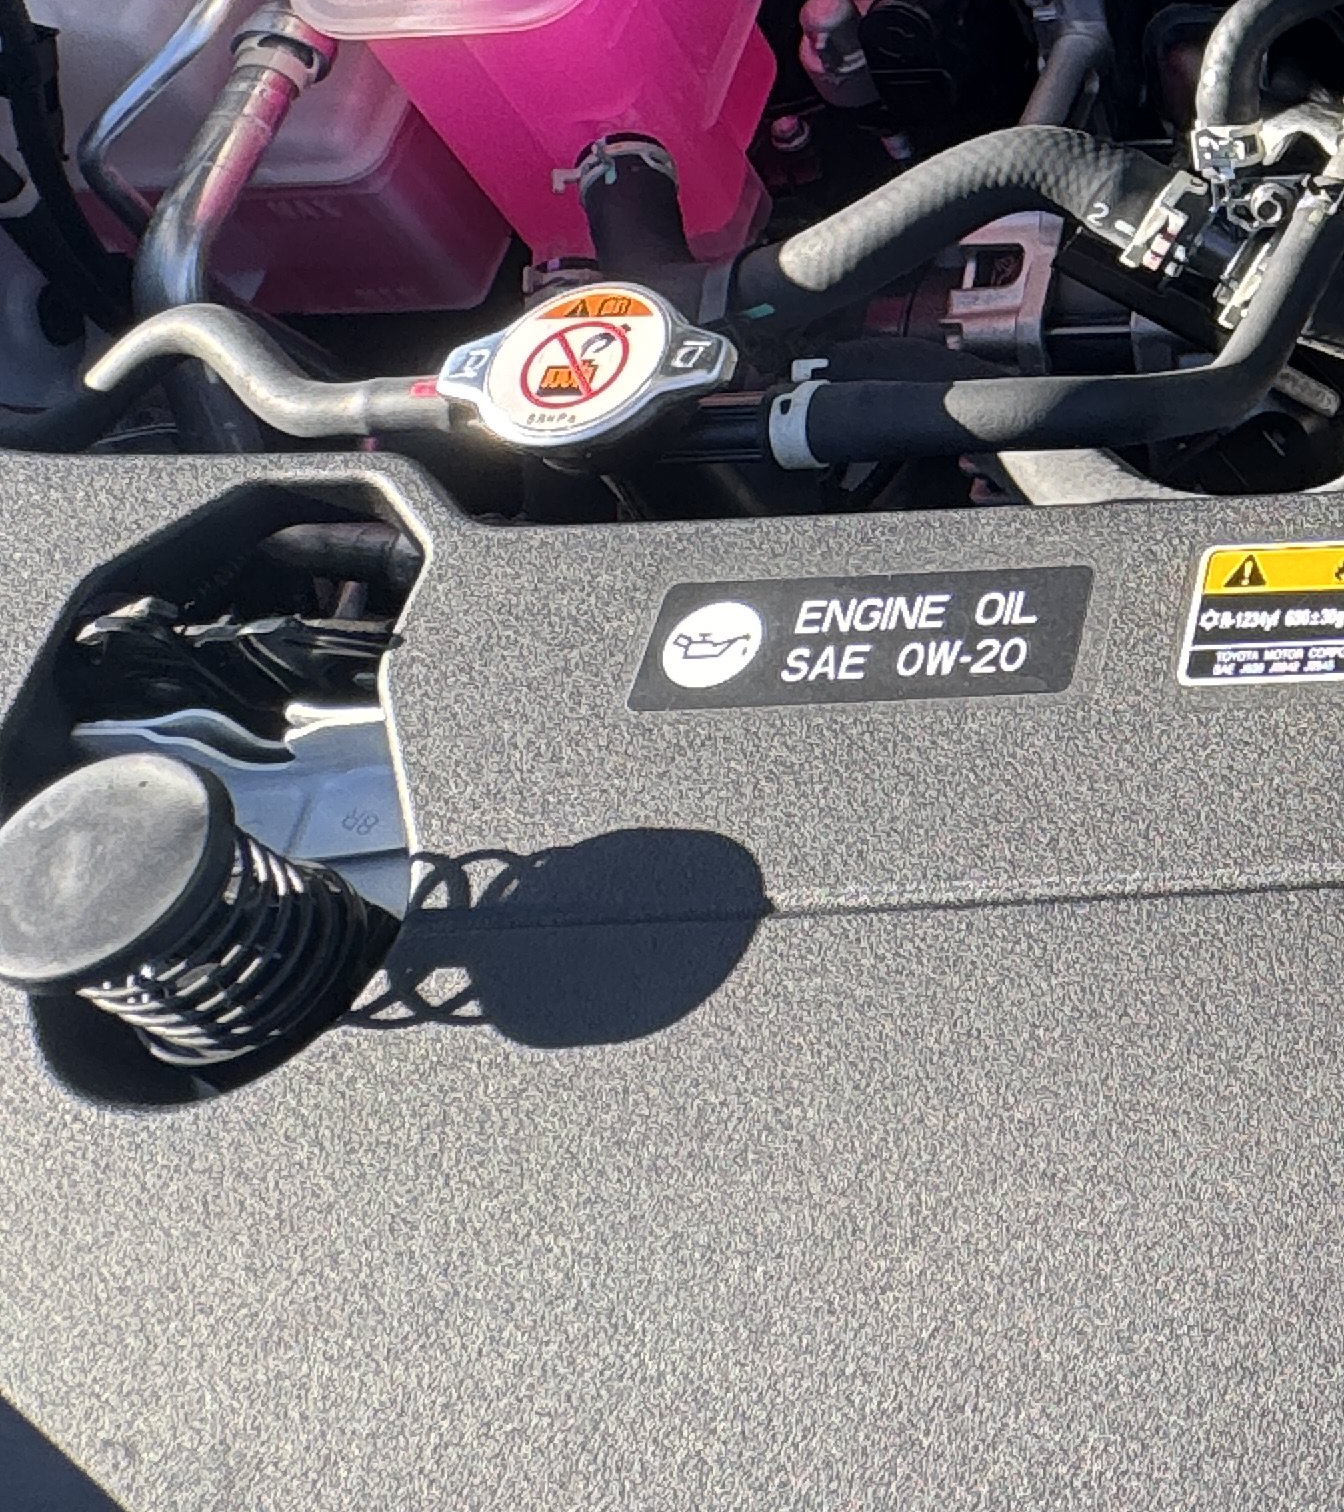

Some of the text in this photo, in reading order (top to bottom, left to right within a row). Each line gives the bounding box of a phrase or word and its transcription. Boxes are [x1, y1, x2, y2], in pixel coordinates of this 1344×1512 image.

[794, 590, 1038, 635] ENGINE OIL
[780, 636, 1028, 683] SAE 0W-20
[1216, 650, 1260, 663] TOYOTA
[1263, 648, 1304, 661] MOTOR
